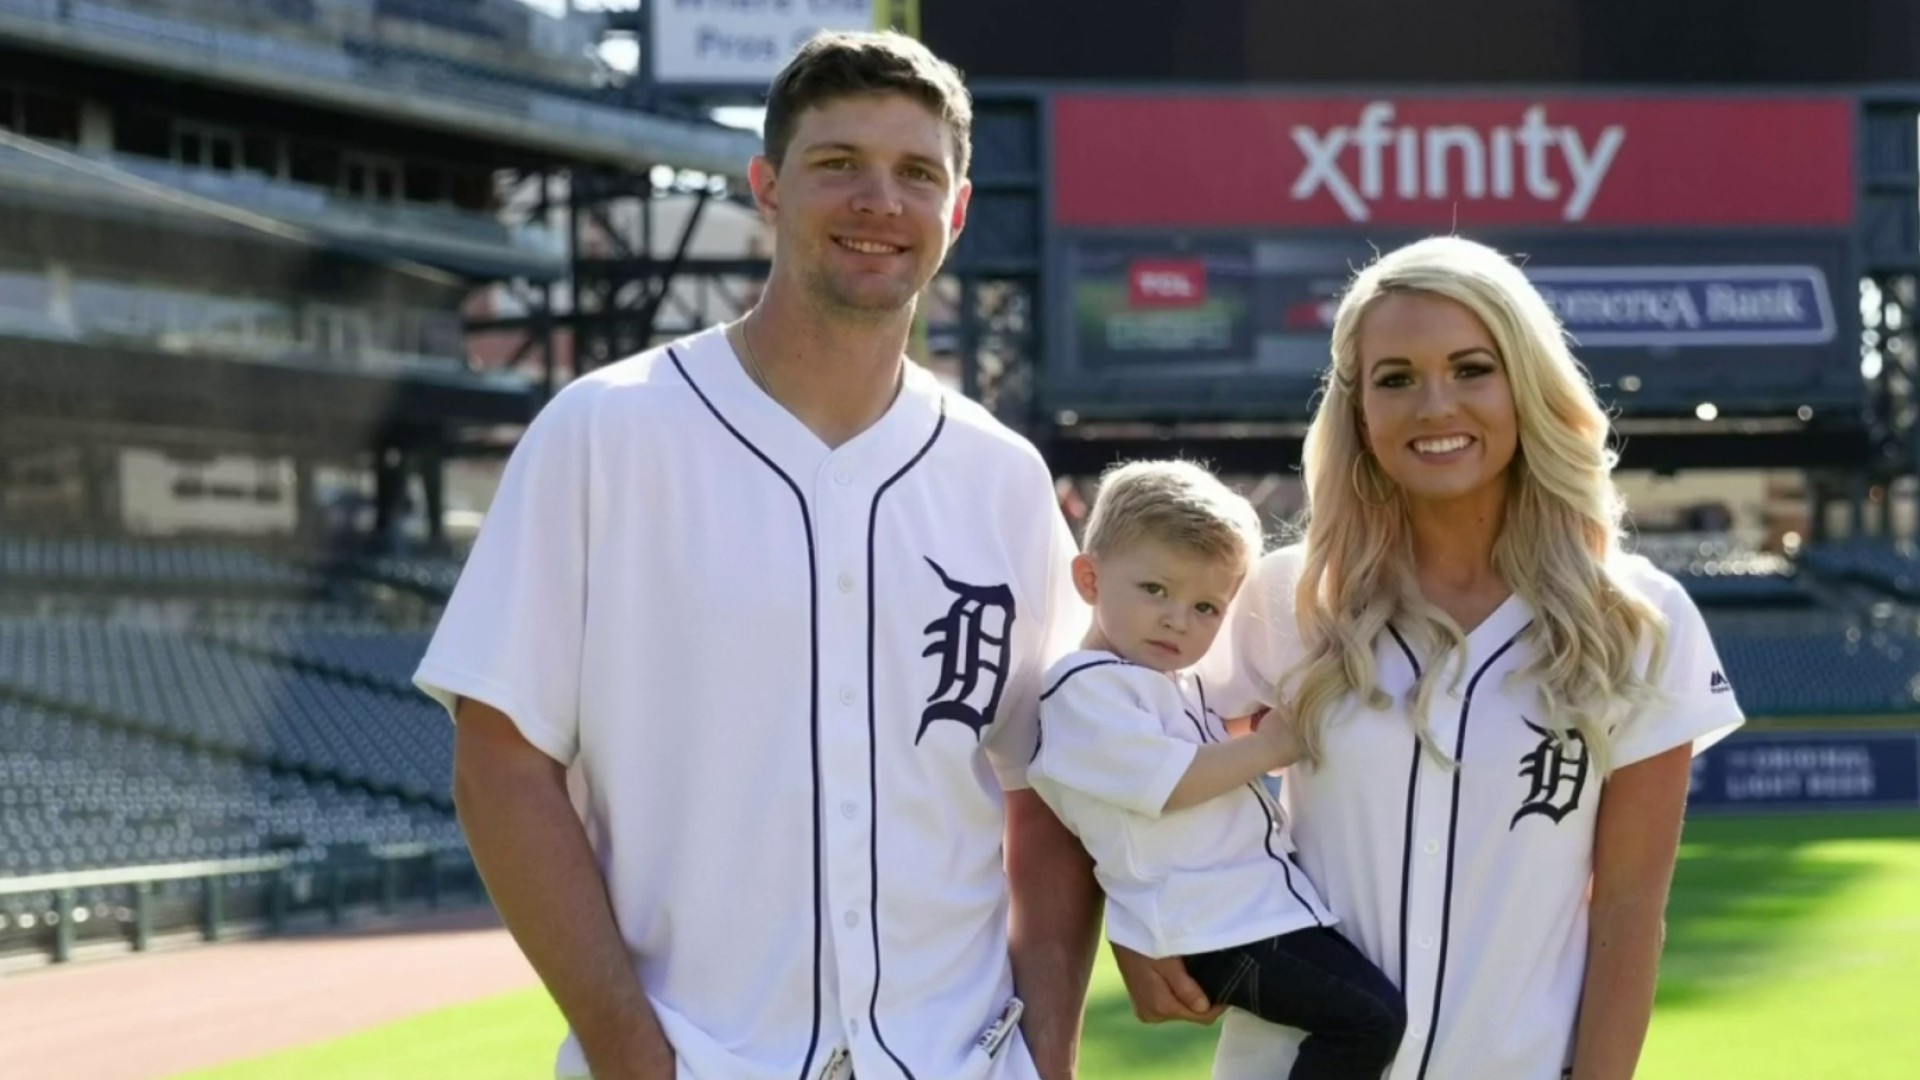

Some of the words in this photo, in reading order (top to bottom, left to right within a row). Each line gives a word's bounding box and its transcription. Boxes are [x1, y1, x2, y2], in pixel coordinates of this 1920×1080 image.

[1290, 101, 1627, 221] xfinity
[1705, 283, 1807, 323] Bank
[914, 555, 1017, 747] D
